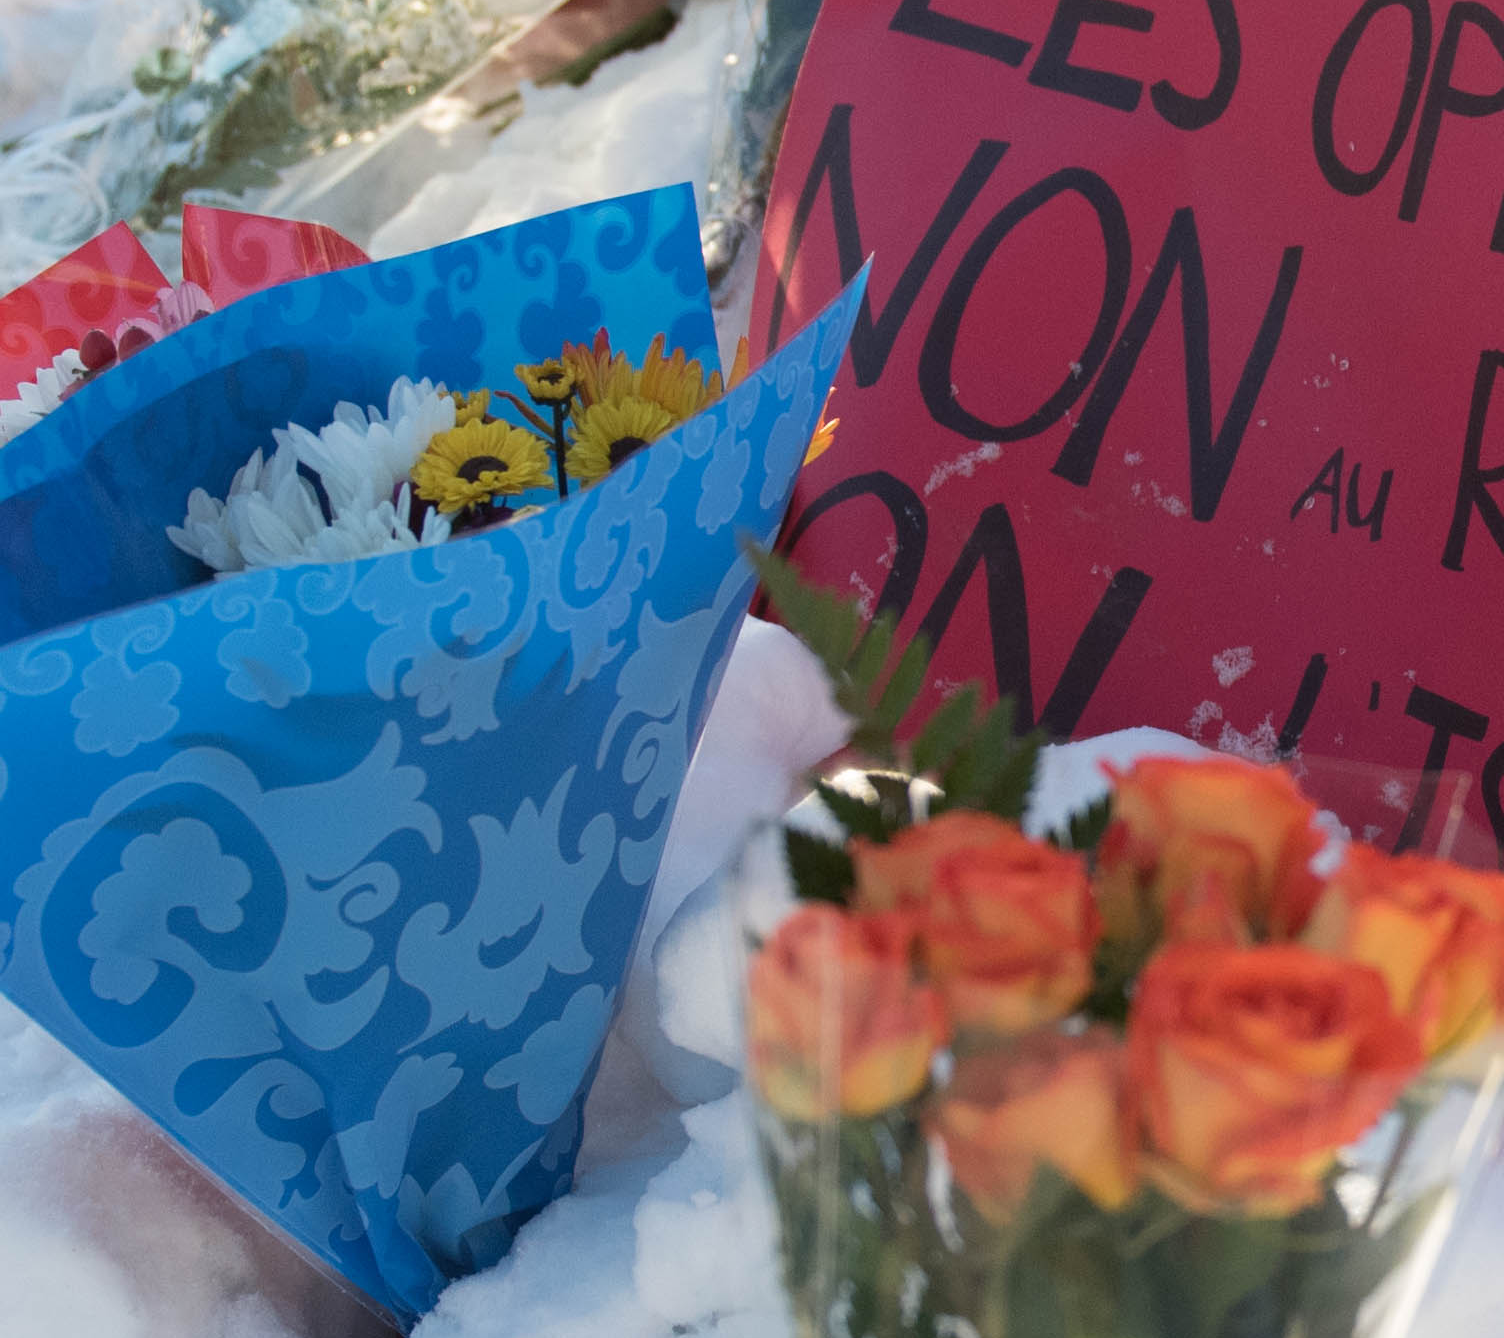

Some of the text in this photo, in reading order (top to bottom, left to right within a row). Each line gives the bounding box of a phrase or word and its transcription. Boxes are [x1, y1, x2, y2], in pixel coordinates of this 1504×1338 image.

[767, 103, 1304, 523] NON
[1291, 447, 1394, 542] AU
[751, 469, 1154, 741] ON
